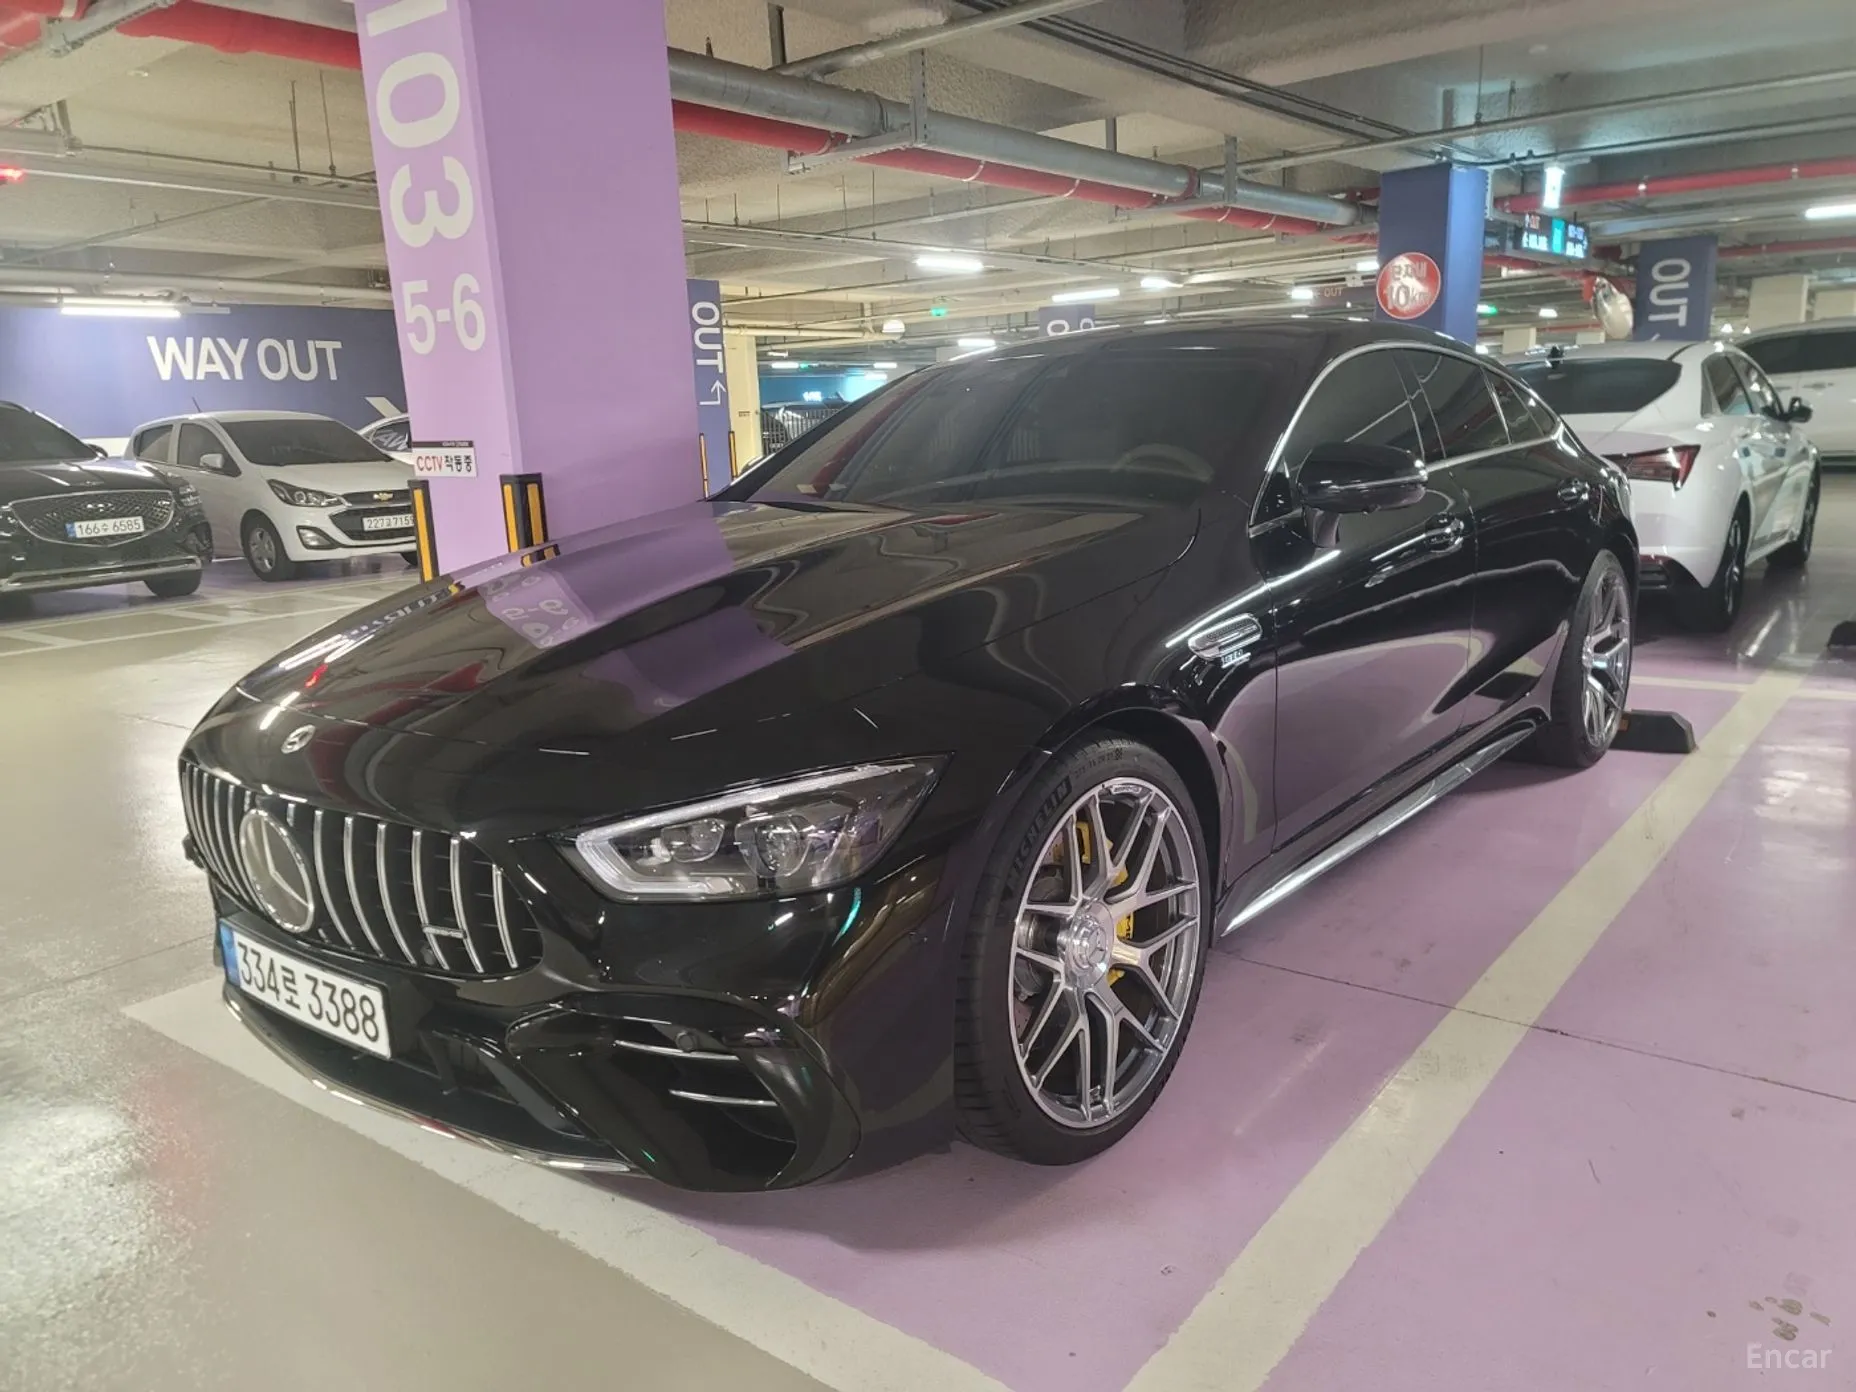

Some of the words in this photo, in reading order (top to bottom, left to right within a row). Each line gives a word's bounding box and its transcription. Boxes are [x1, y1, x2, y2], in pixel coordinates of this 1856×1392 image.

[402, 273, 486, 355] 5-6
[1648, 258, 1691, 327] OUT
[146, 336, 249, 381] WAY
[256, 338, 343, 381] OUT
[692, 301, 724, 373] OUT
[416, 455, 443, 472] CCTV
[112, 518, 140, 533] 6585
[237, 941, 301, 1009] 334로
[305, 973, 379, 1042] 3388
